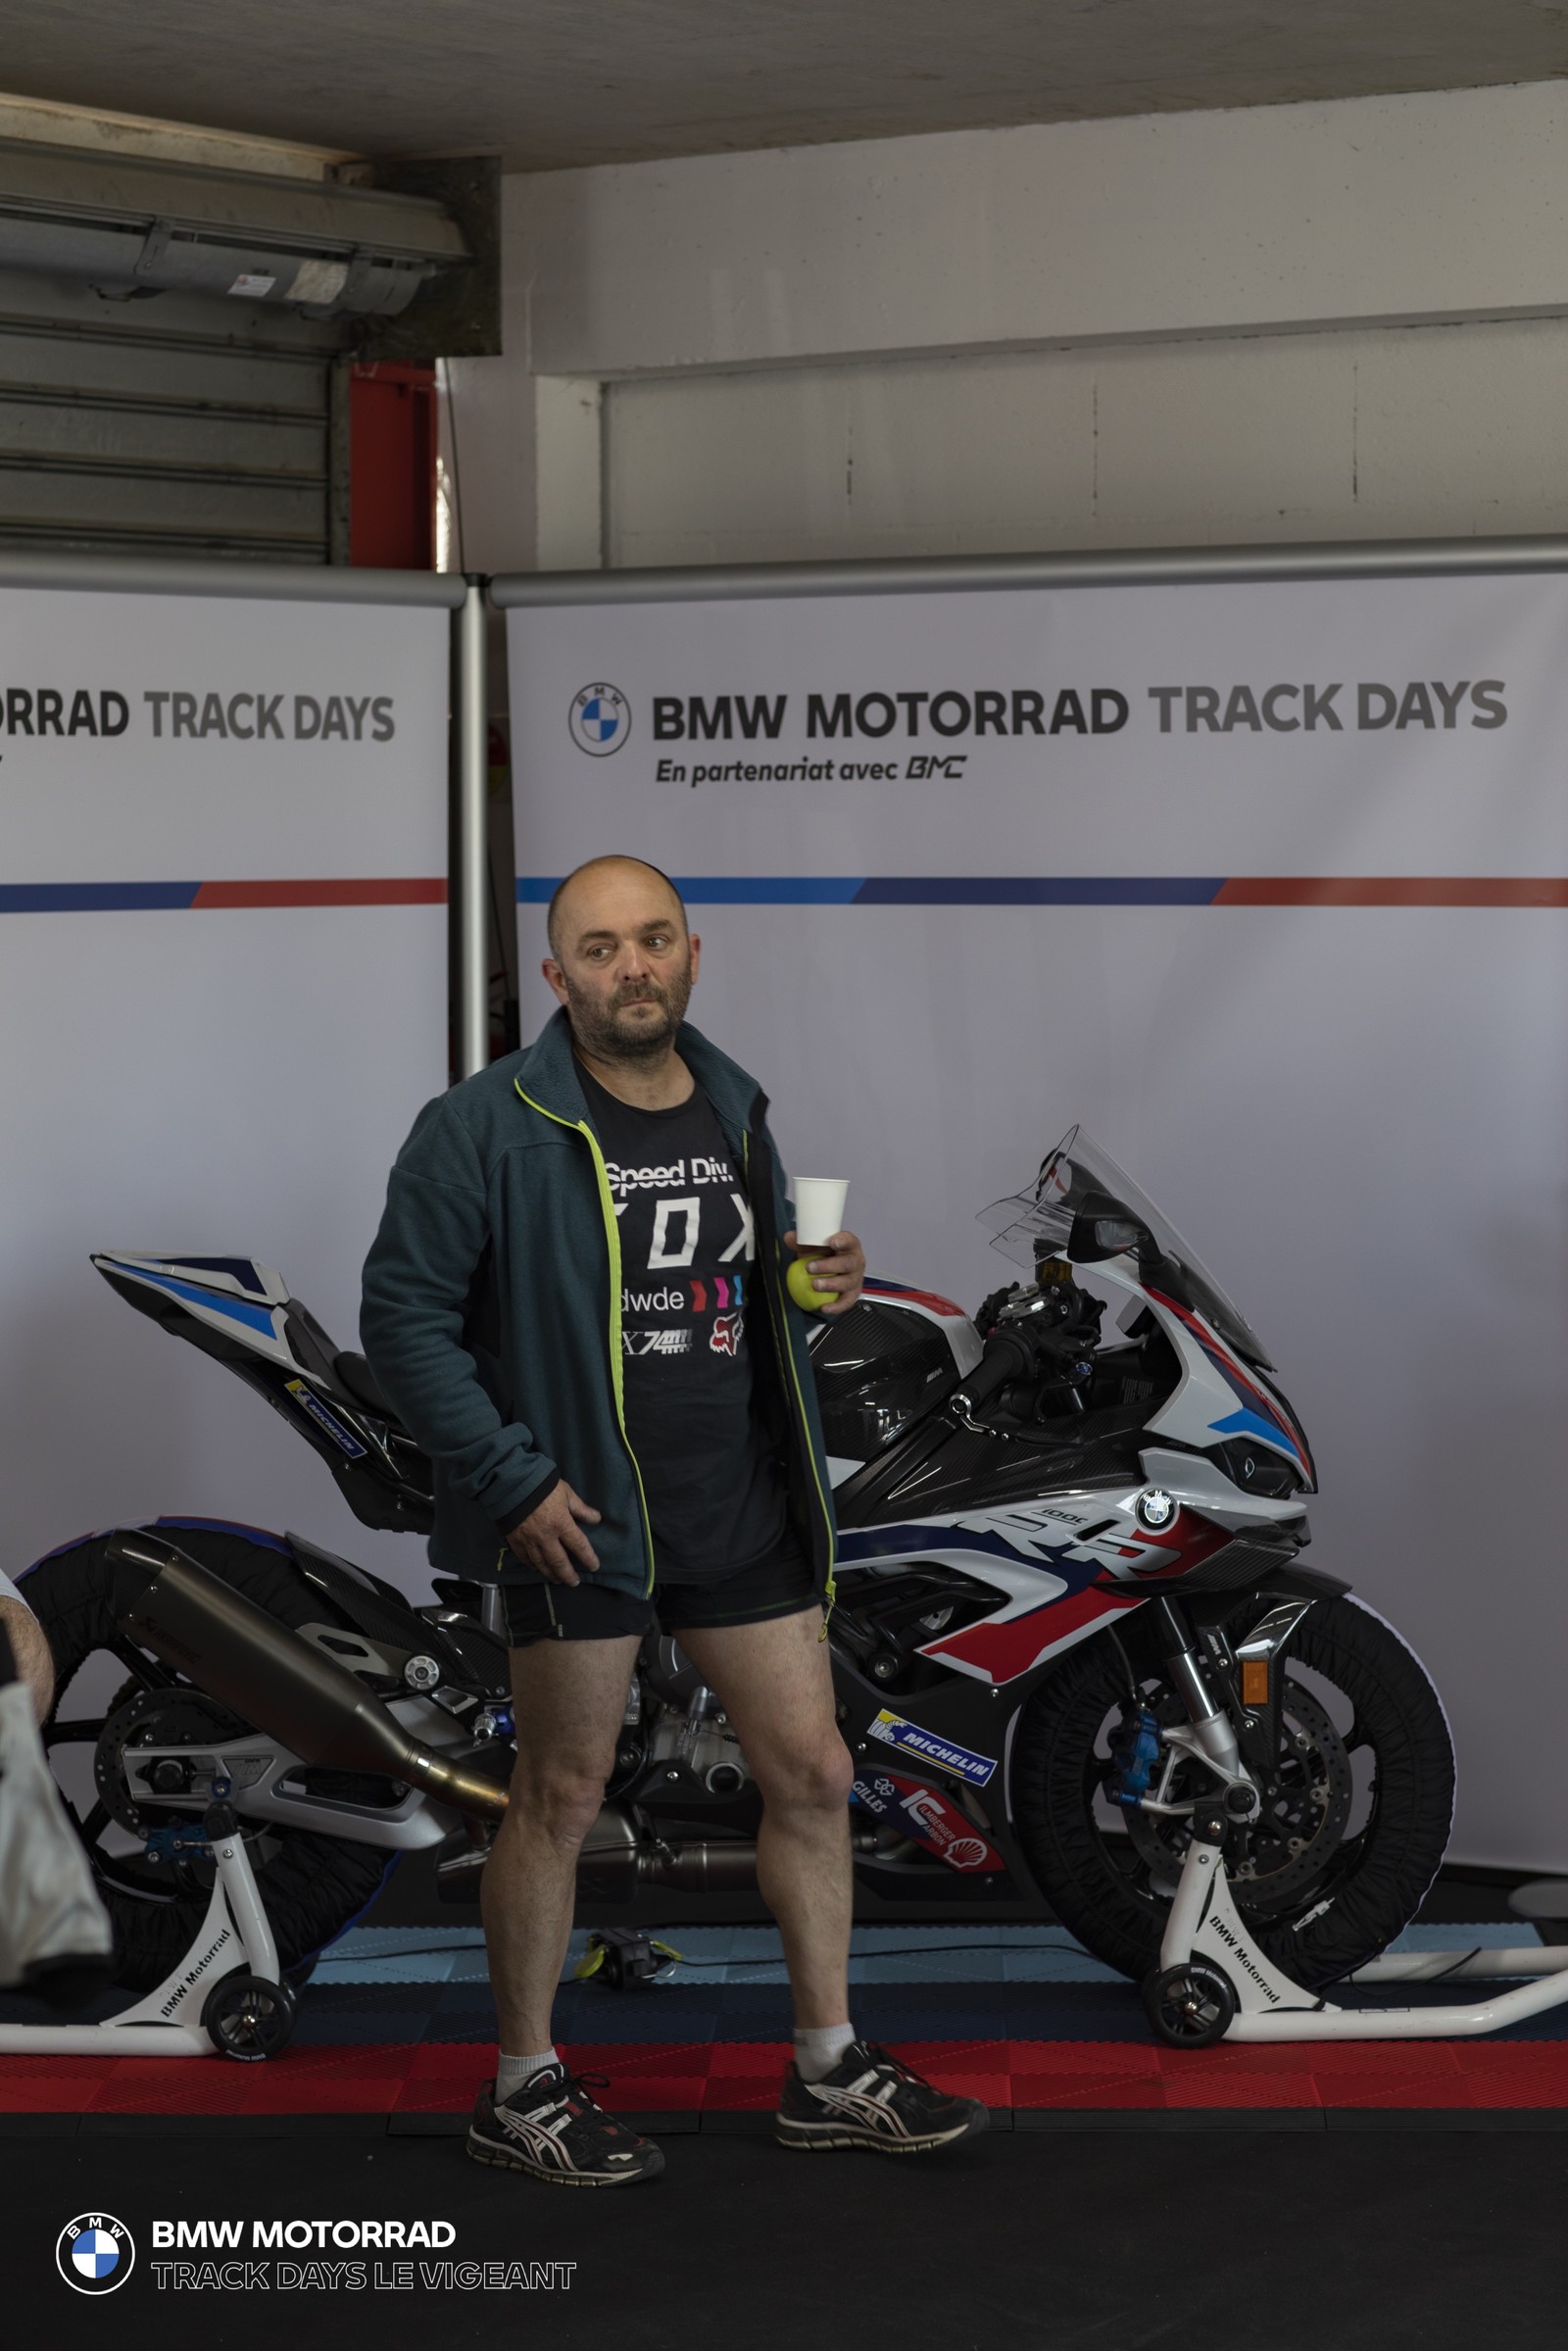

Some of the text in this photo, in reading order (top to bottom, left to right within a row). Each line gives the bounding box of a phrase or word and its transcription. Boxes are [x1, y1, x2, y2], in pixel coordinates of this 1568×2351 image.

[0, 688, 396, 743] RRAD TRACK DAYS
[653, 679, 1508, 741] BMW MOTORRAD TRACK DAYS
[656, 756, 967, 788] En partenariat avec BMC
[605, 1159, 686, 1198] Speed
[613, 1193, 756, 1270] OX
[308, 1403, 355, 1449] MICHELIN
[903, 1732, 990, 1776] MICHELIN
[852, 1781, 888, 1813] GILLES
[161, 1928, 231, 2018] BMW Motorrad
[1208, 1915, 1281, 2003] BMW Motorrad
